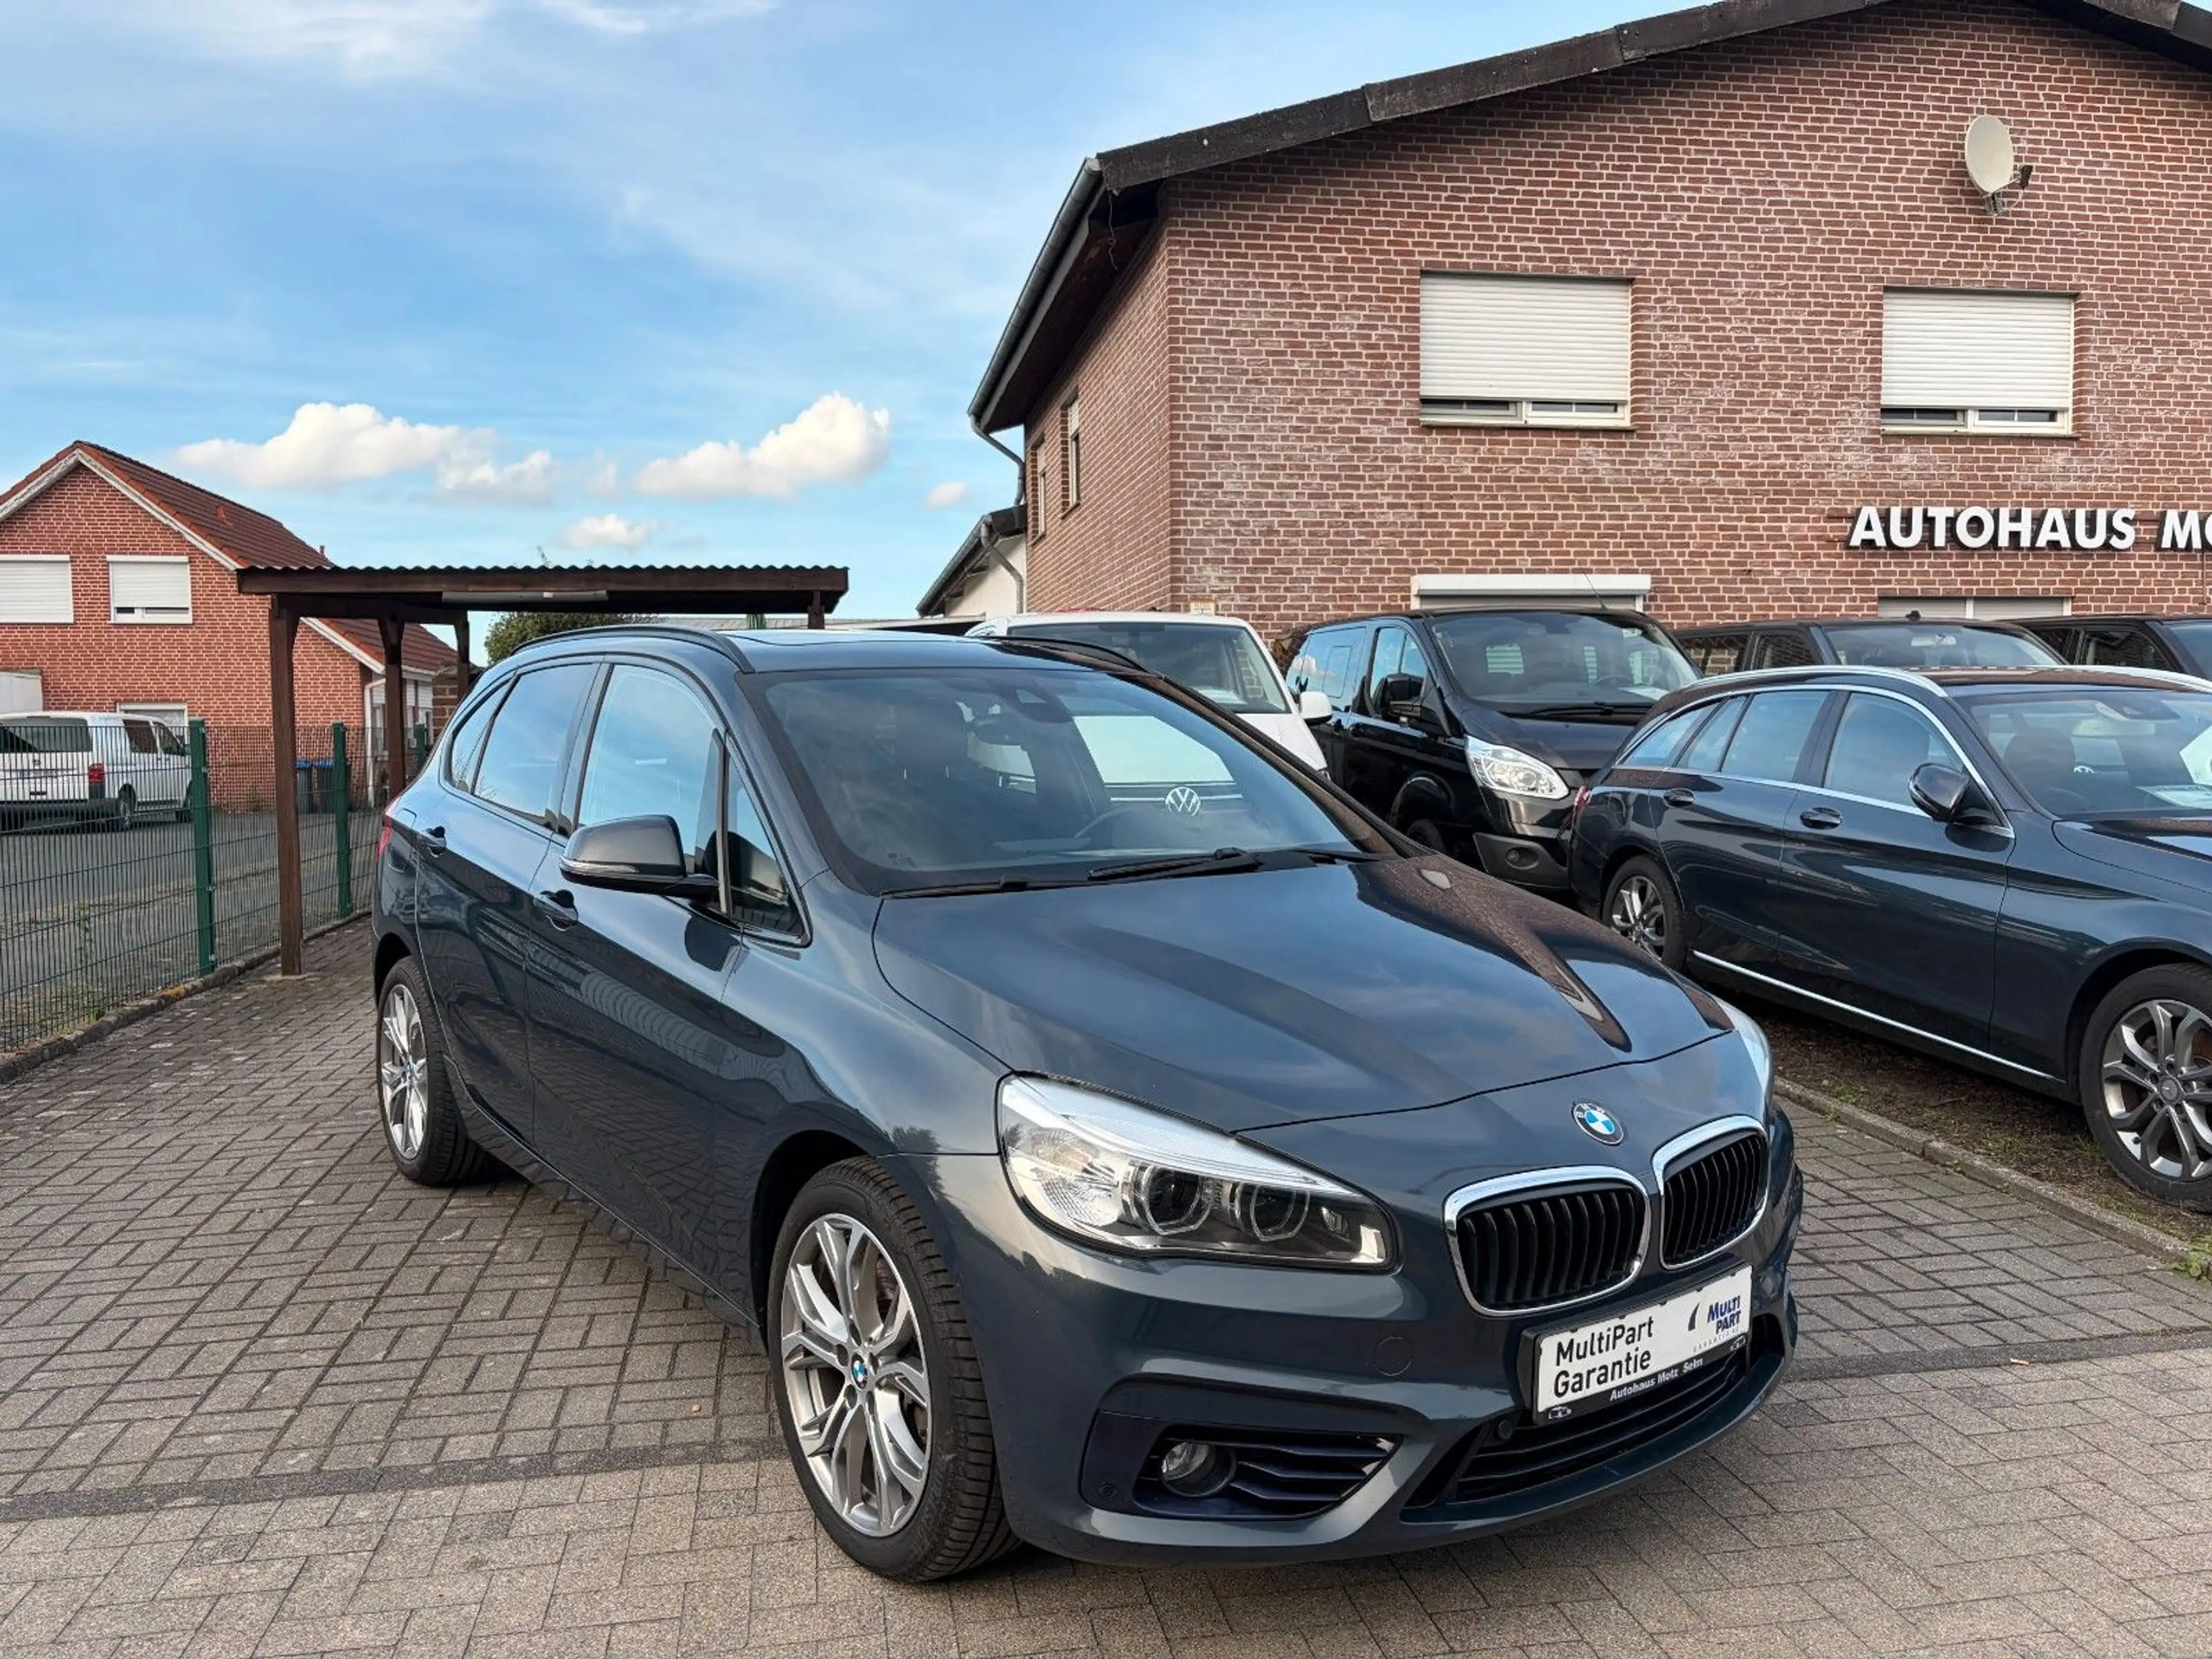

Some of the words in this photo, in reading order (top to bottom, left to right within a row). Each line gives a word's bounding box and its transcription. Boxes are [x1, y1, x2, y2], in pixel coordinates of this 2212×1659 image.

[1849, 505, 2136, 551] AUTOHAUS
[2161, 509, 2212, 549] M
[1707, 1295, 1741, 1323] MULTI
[1715, 1309, 1741, 1335] PART
[1556, 1316, 1654, 1366] MultiPart
[1554, 1347, 1652, 1398] Garantie
[1609, 1377, 1656, 1401] Autohaus
[1657, 1368, 1679, 1384] Motz
